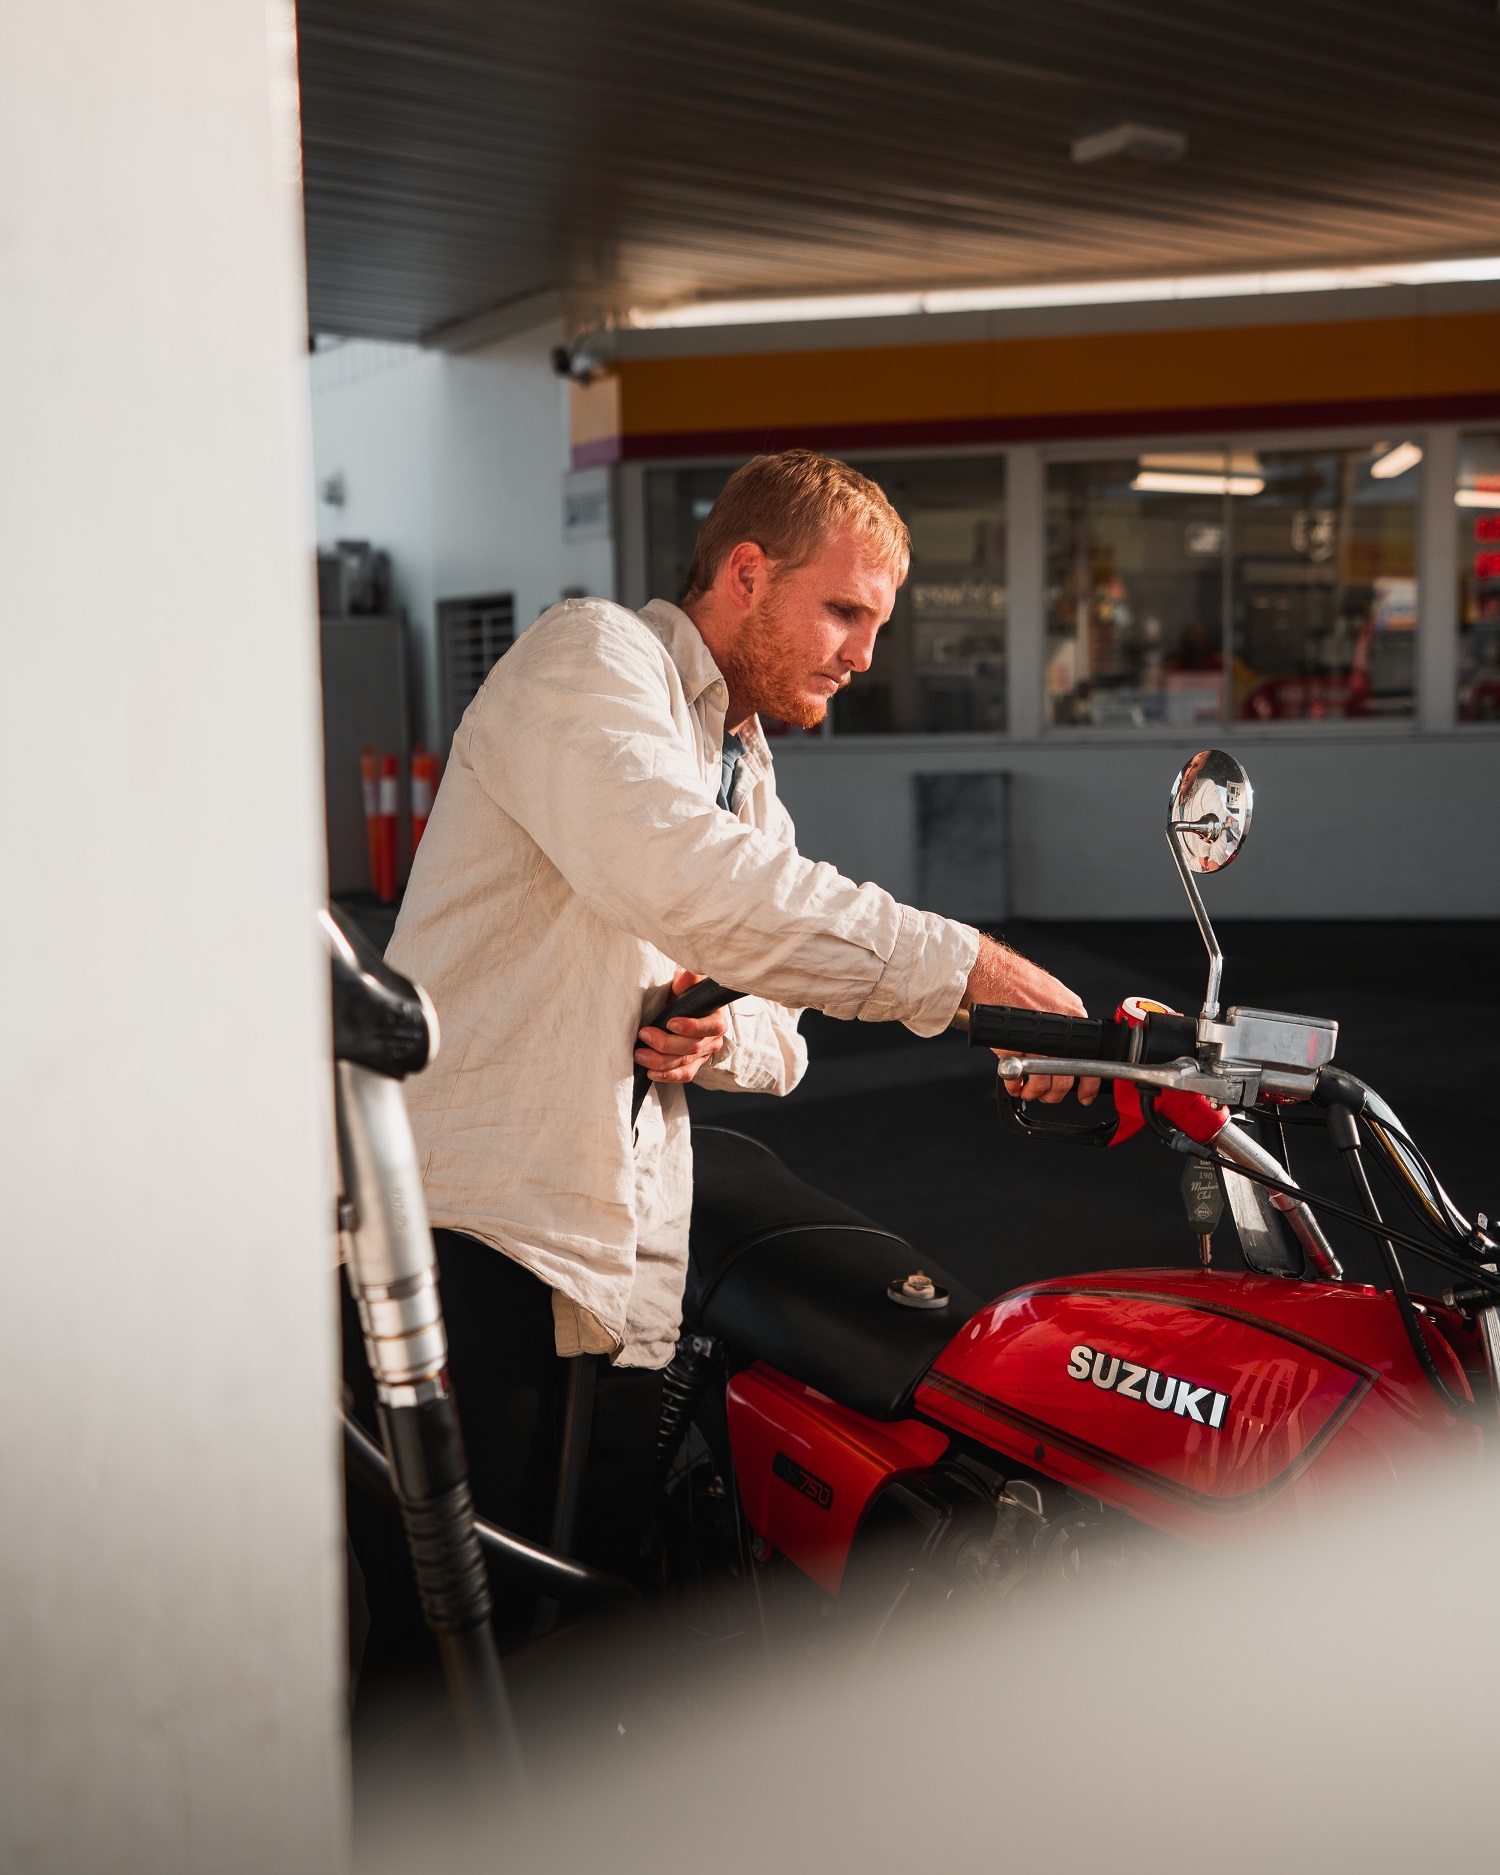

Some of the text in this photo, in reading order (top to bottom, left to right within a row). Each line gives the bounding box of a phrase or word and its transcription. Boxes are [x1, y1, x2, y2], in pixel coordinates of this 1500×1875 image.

[1199, 1172, 1213, 1180] 190
[1067, 1345, 1230, 1429] SUZUKI
[799, 1470, 830, 1506] 750
